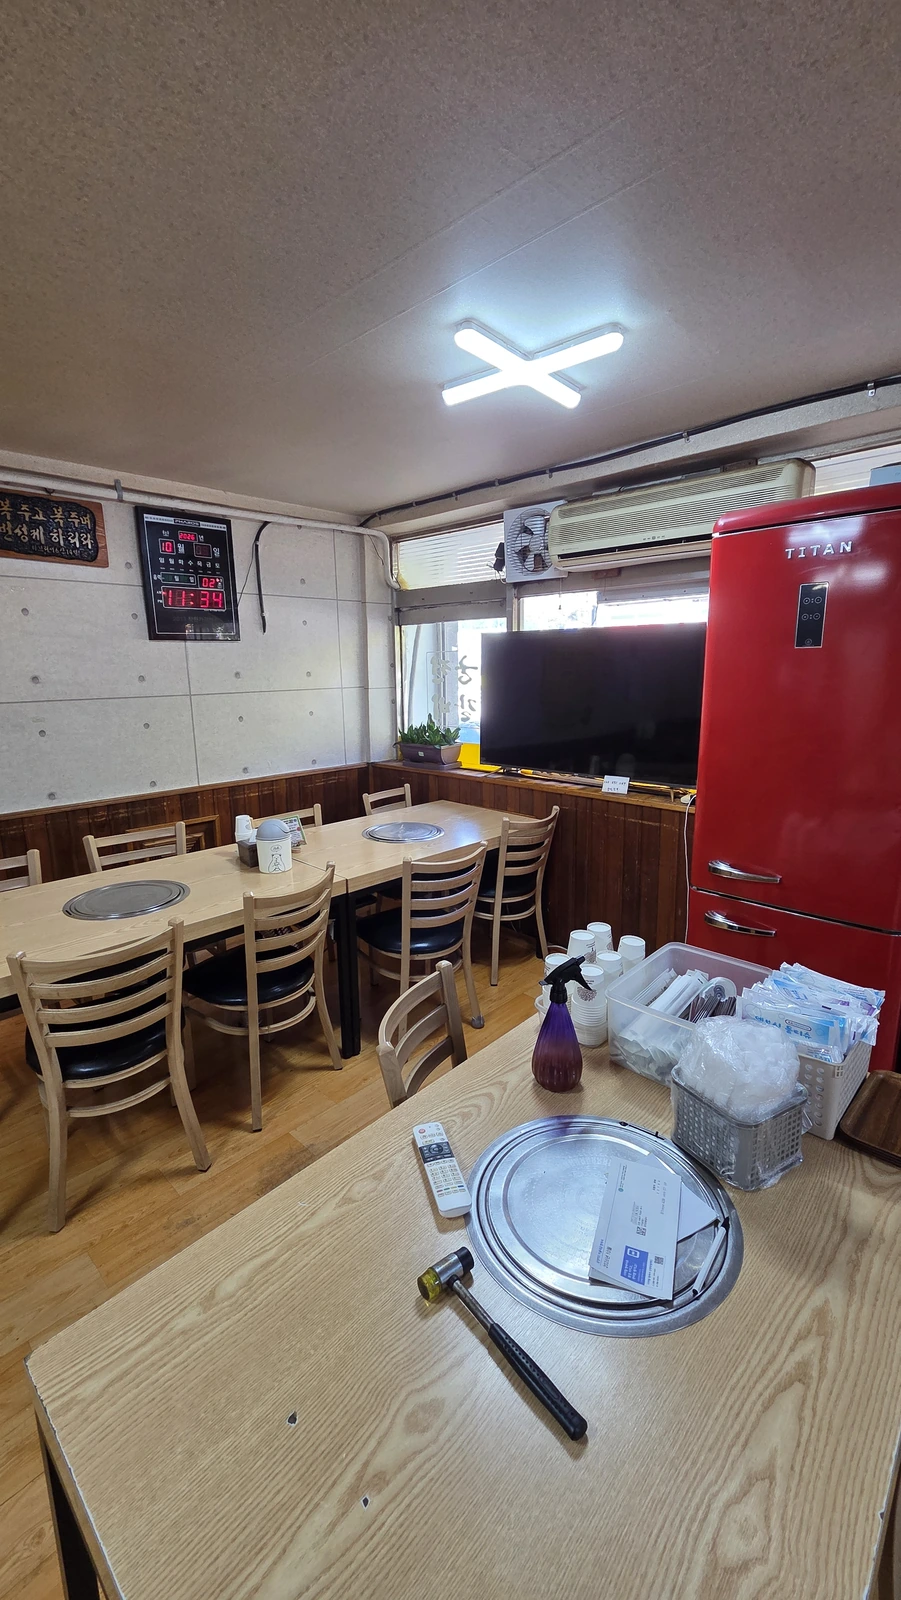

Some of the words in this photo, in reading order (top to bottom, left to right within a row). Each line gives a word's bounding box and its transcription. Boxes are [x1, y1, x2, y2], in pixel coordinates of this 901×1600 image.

[17, 504, 47, 521] 주고
[50, 506, 65, 527] 복
[50, 528, 93, 550] 하리라
[161, 541, 173, 553] 10
[785, 541, 853, 559] TITAN
[202, 577, 216, 588] 02
[168, 589, 223, 608] 11:34
